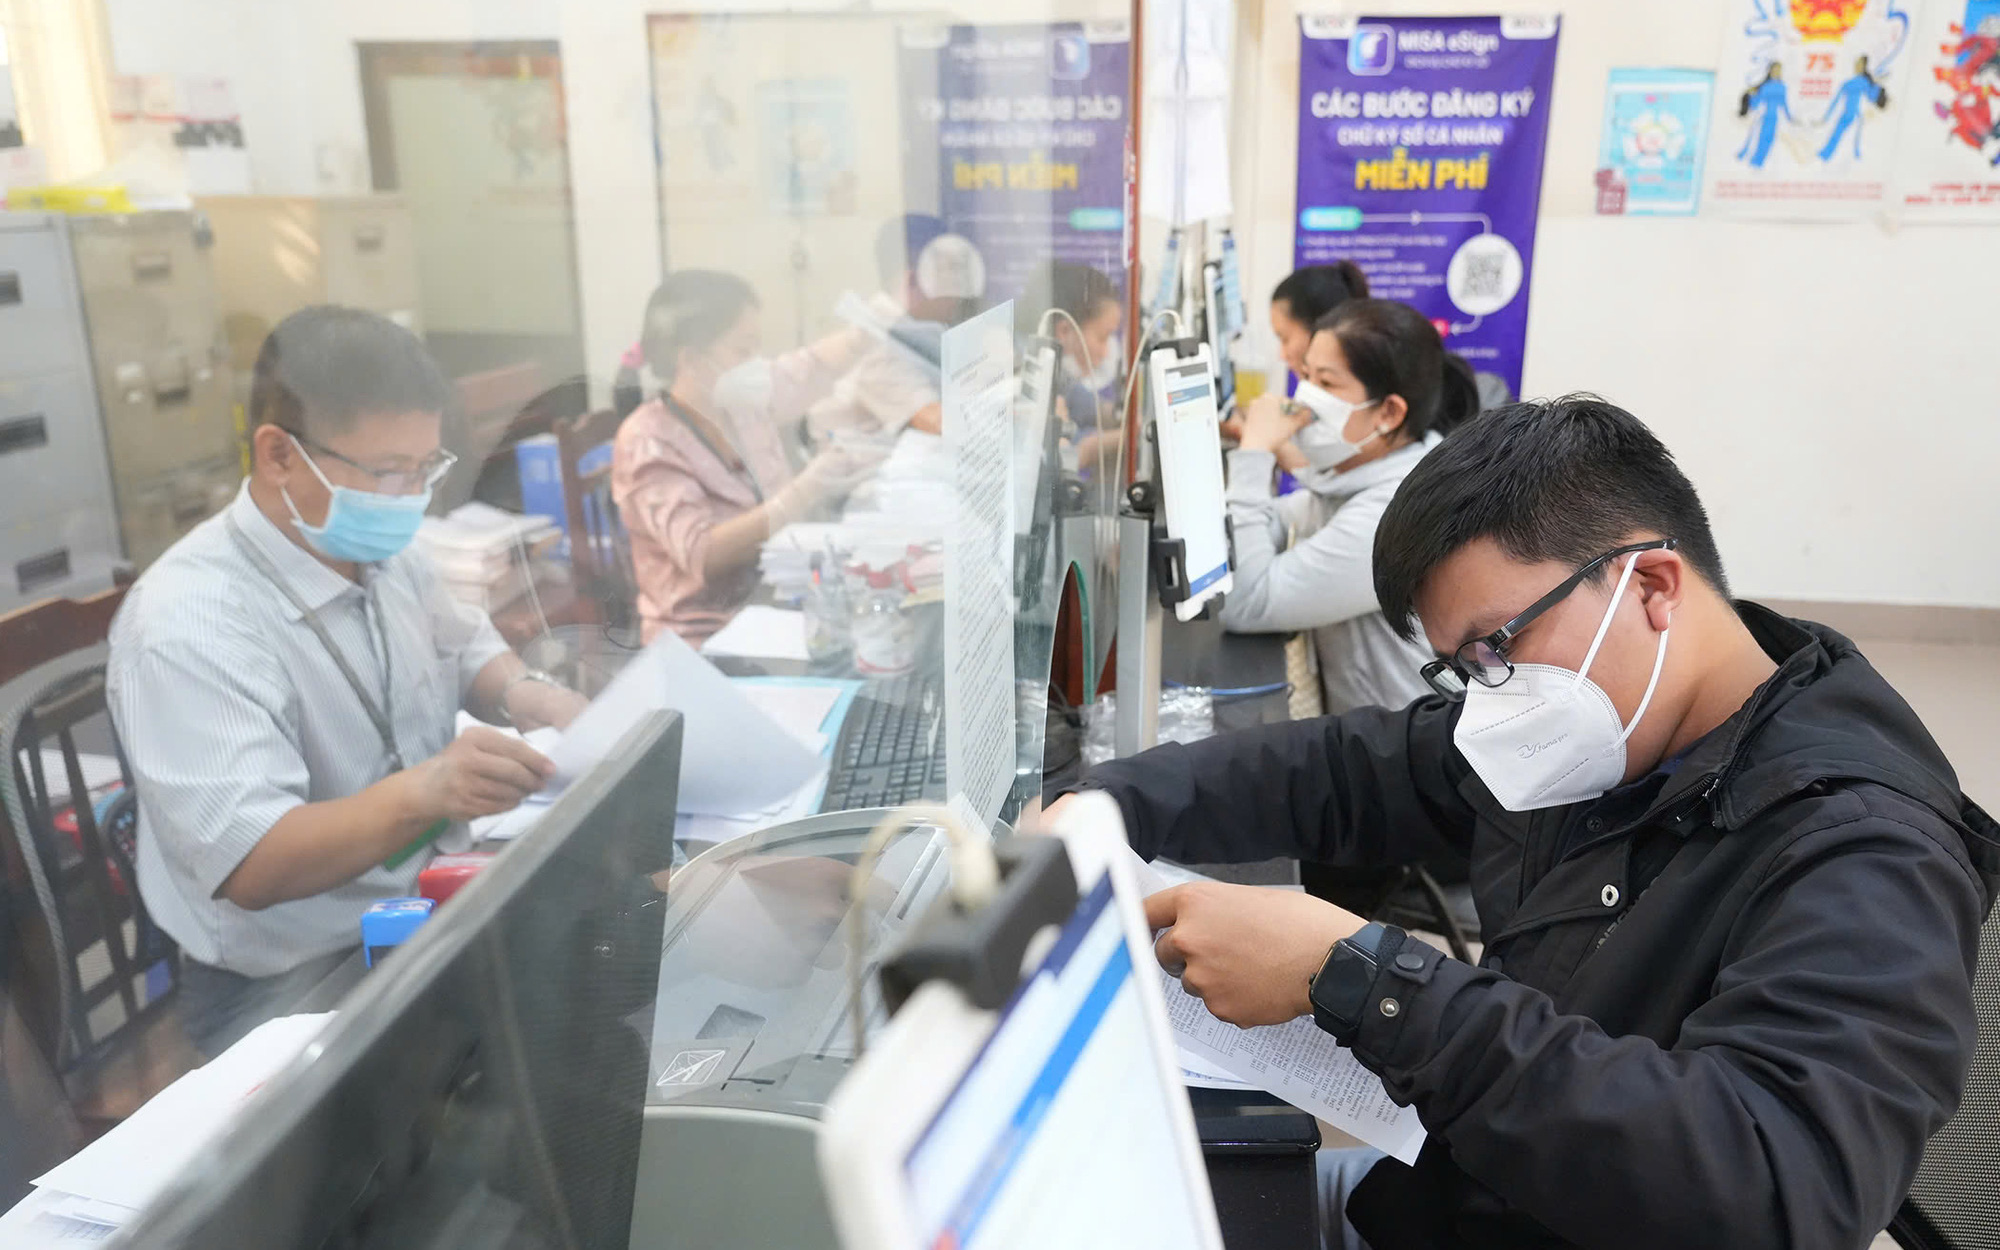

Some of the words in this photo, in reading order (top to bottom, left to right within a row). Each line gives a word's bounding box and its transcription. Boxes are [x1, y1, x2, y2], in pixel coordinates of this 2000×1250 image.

[1398, 31, 1444, 51] MISA
[1311, 87, 1360, 118] CÁC
[1363, 87, 1428, 118] BƯỚC
[1431, 87, 1498, 118] ĐĂNG
[1501, 86, 1535, 117] KÝ
[1355, 147, 1431, 189] MIỄN
[1435, 152, 1489, 189] PHÍ
